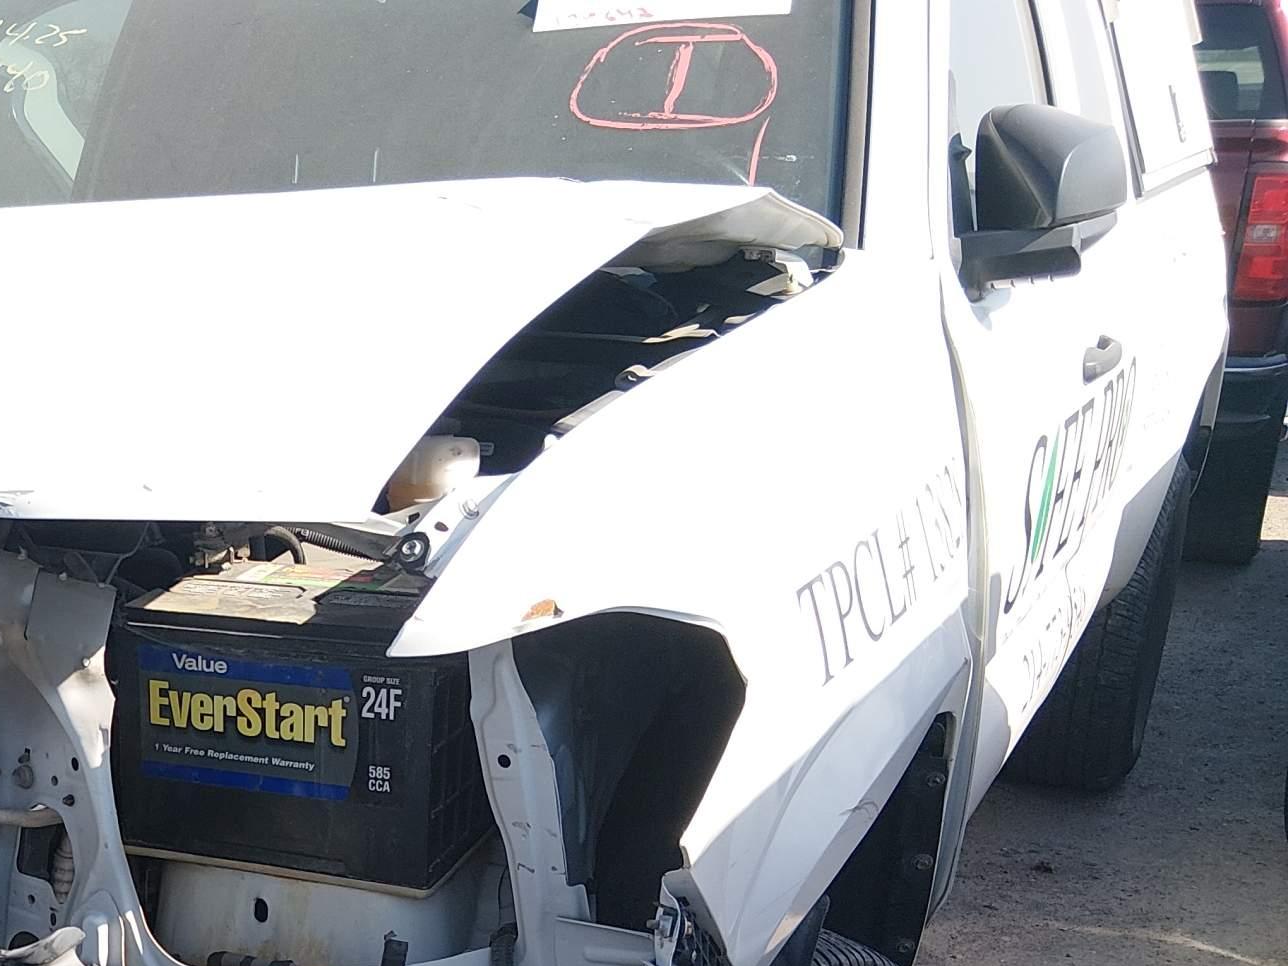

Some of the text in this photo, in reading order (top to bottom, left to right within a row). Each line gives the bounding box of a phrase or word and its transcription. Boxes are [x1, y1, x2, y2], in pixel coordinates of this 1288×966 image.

[172, 653, 228, 674] Value
[363, 674, 401, 686] GROUP SIZE
[149, 679, 347, 747] EverStart
[362, 686, 403, 721] 24F
[162, 743, 183, 754] Year
[184, 746, 205, 757] Free
[207, 749, 269, 765] Replacement
[271, 757, 315, 772] Warranty
[368, 765, 391, 779] 585
[368, 779, 391, 793] CCA
